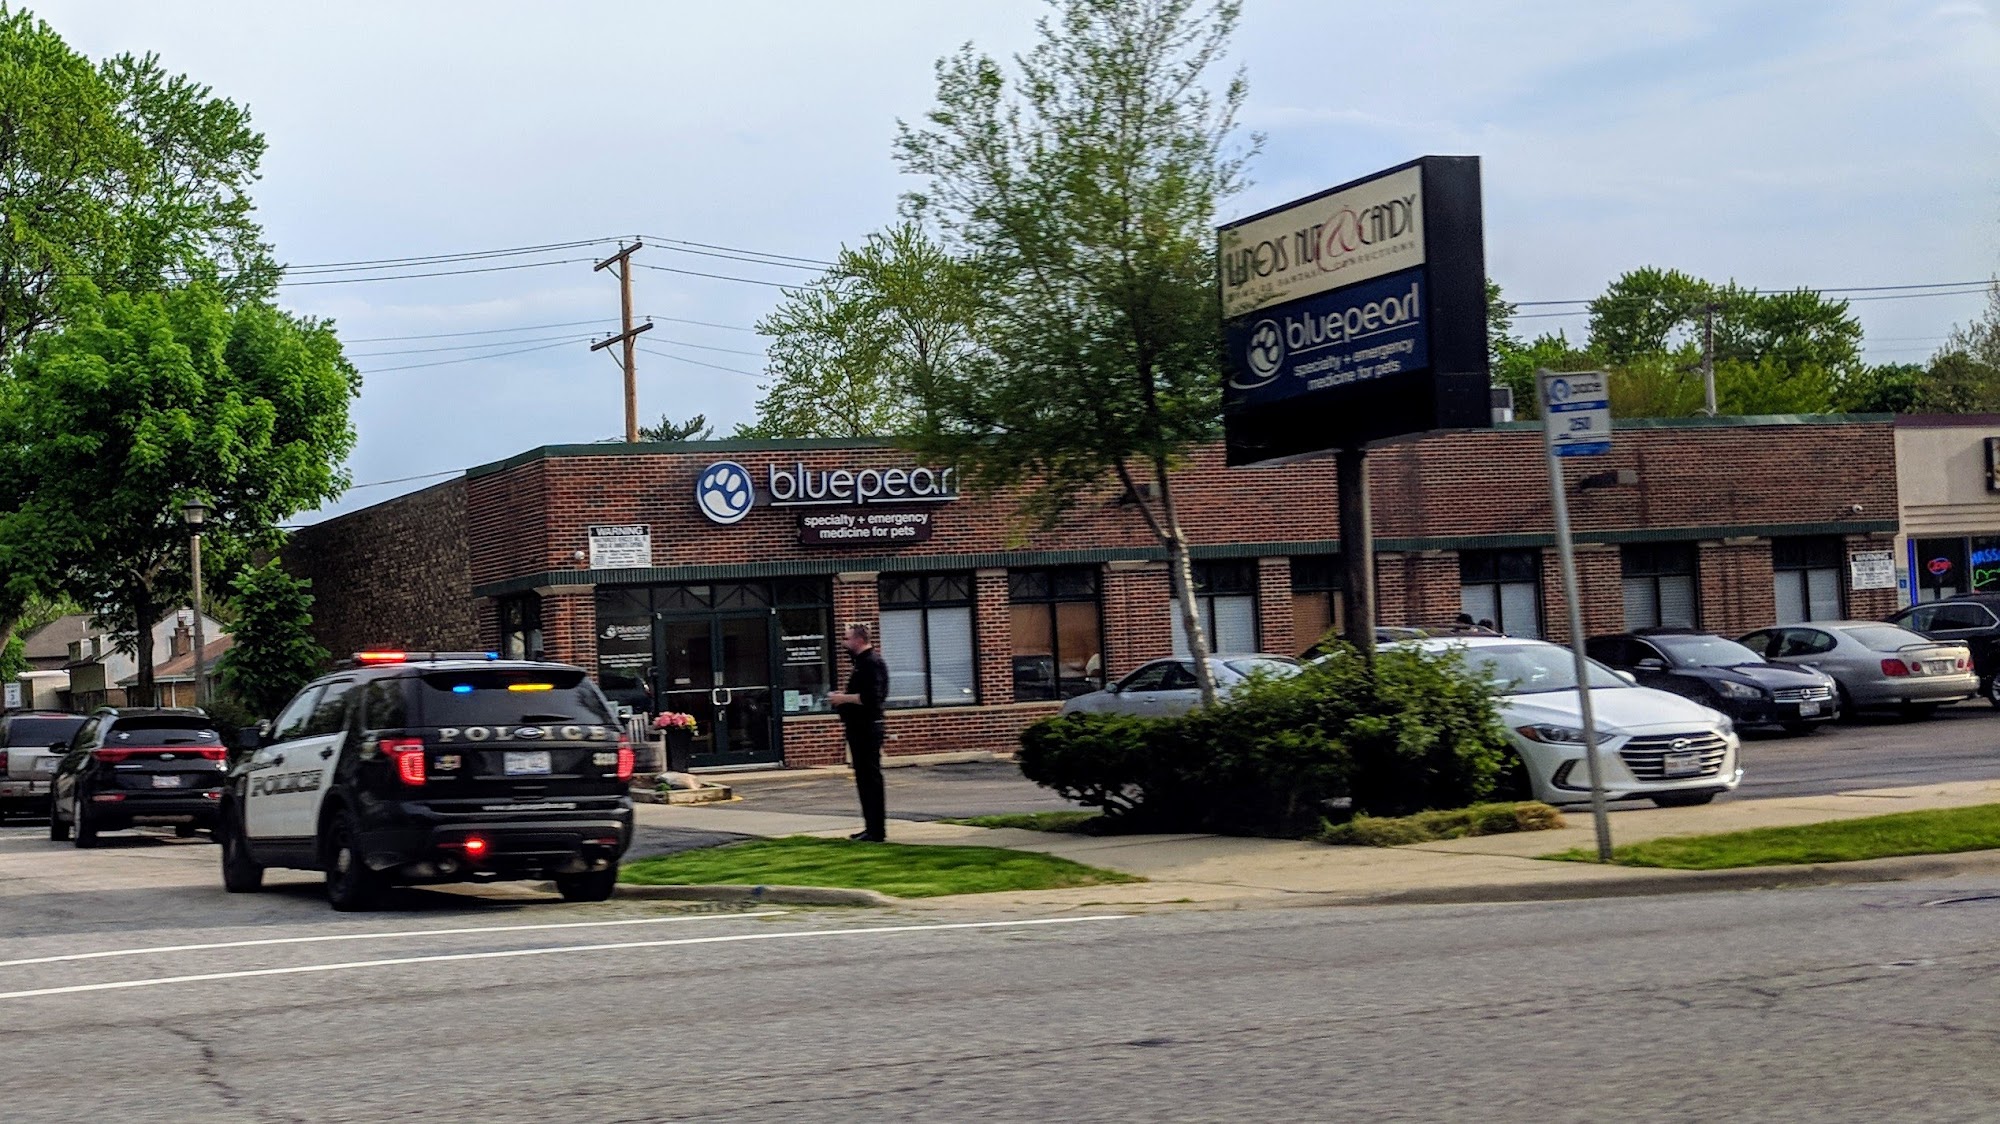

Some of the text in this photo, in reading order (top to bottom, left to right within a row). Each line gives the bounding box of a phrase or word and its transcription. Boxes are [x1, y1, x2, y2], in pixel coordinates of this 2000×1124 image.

[1357, 194, 1416, 245] CANDY
[1285, 282, 1420, 349] bluepearl
[1293, 355, 1341, 378] specialty
[1352, 339, 1415, 362] emergency
[1307, 360, 1401, 391] medicine for pets
[769, 462, 960, 504] bluepearl
[596, 526, 643, 536] WARNING
[804, 513, 929, 528] specialty + emergency
[819, 525, 915, 539] medicine for pets
[438, 725, 607, 742] POLICE
[251, 769, 323, 797] POLICE
